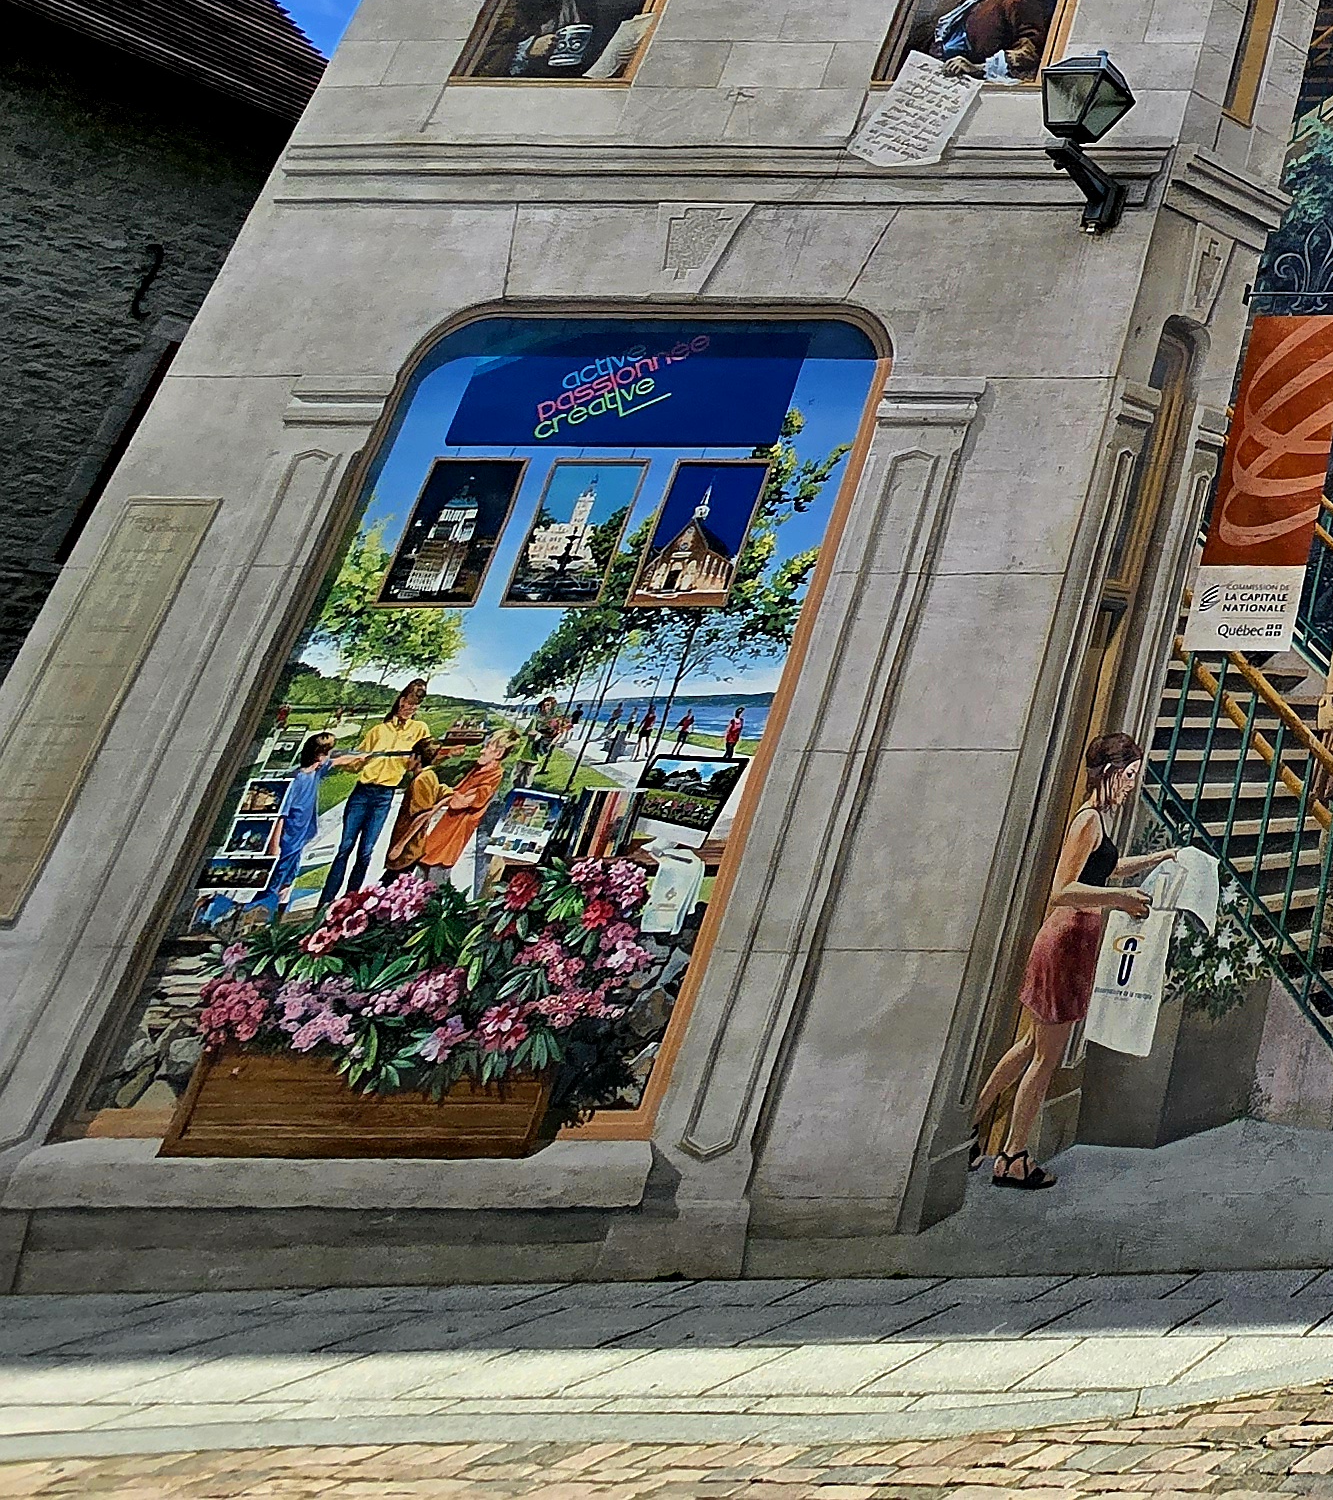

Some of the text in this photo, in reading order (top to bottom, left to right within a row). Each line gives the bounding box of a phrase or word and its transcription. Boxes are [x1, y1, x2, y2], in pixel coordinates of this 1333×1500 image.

[562, 344, 646, 389] active
[537, 335, 710, 423] passionnée
[534, 377, 656, 439] créative
[1226, 583, 1278, 591] COMMISSION
[1225, 593, 1288, 602] LA CAPITALE
[1222, 604, 1287, 612] NATIONALE
[1218, 624, 1264, 638] Québec
